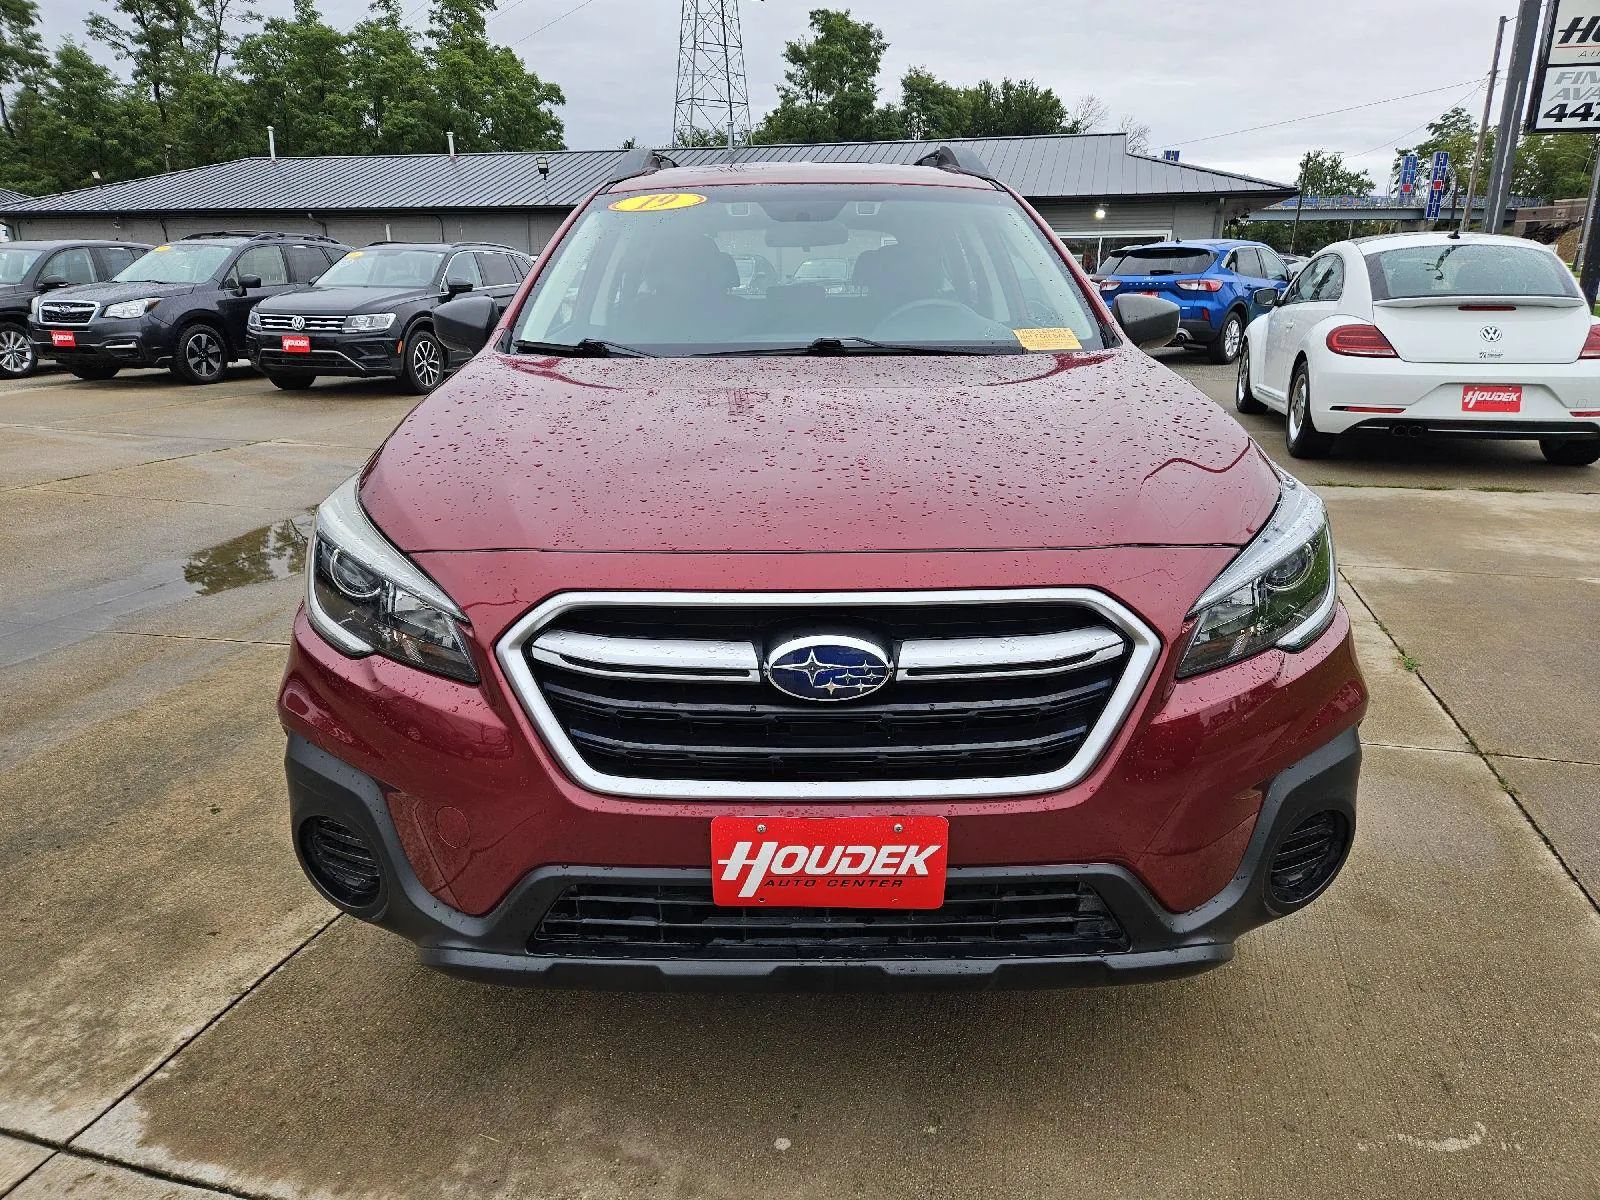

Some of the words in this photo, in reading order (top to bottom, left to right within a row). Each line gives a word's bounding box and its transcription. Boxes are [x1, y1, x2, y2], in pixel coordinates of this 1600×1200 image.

[1464, 391, 1520, 408] HOUDEK
[718, 842, 941, 897] HOUDEK
[764, 879, 816, 888] AUTO
[827, 879, 903, 888] CENTER
